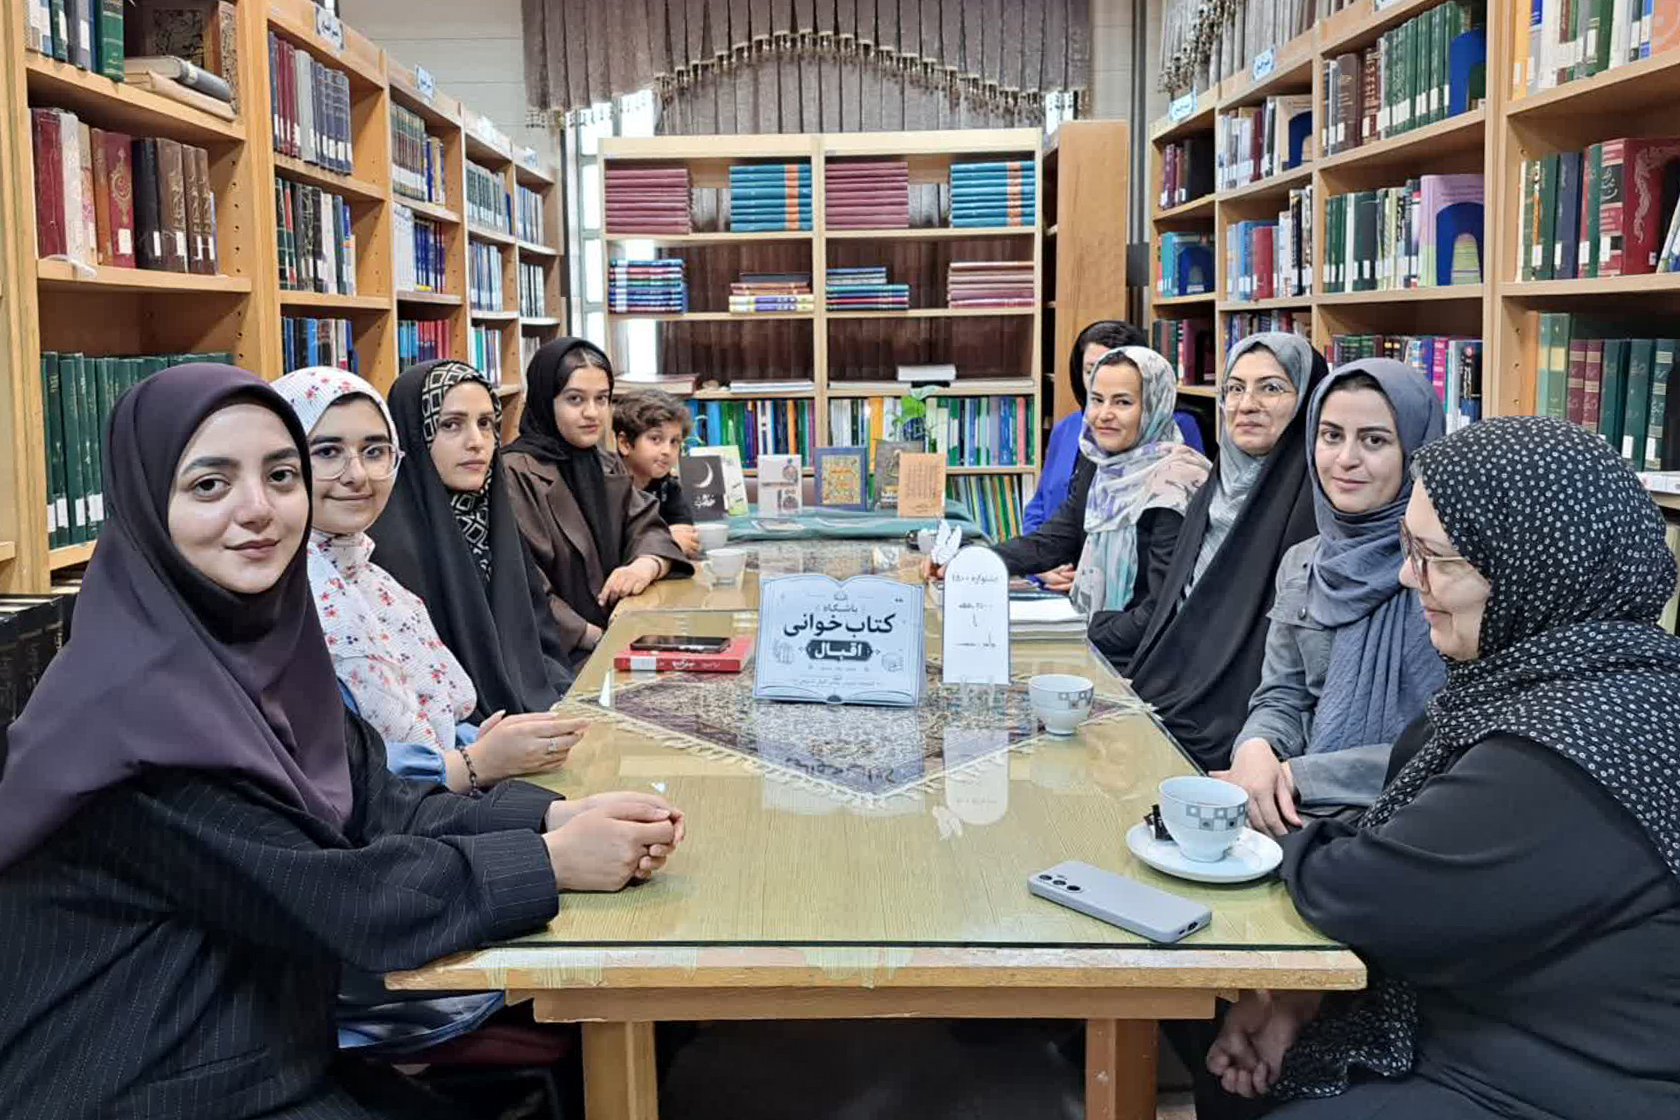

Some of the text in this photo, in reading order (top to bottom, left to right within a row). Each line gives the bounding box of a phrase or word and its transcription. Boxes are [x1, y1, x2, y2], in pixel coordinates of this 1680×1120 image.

[823, 602, 859, 613] باشگاه
[783, 612, 897, 638] کتاب خوانی
[814, 641, 863, 661] اقبال
